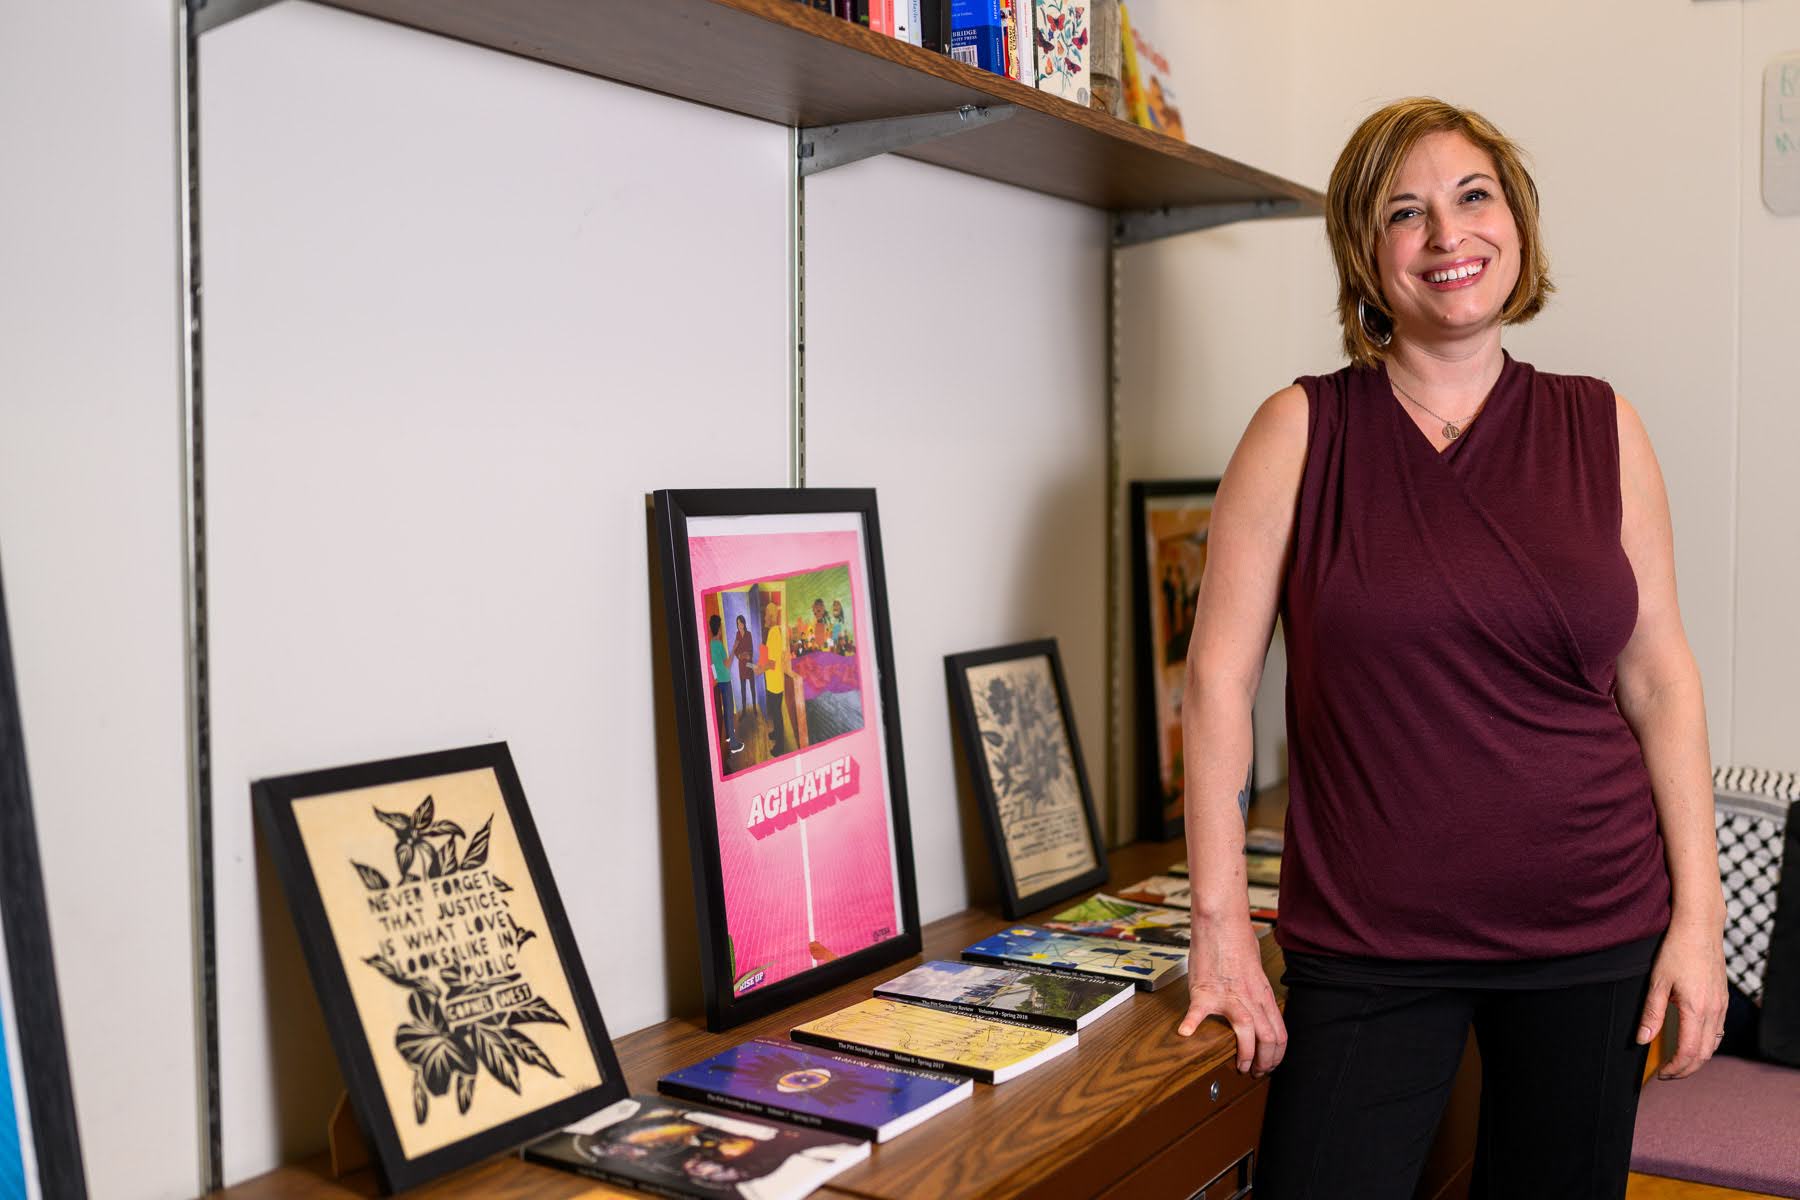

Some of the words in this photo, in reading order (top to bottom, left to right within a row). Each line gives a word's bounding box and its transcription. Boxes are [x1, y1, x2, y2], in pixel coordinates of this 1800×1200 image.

[745, 754, 852, 829] AGITATE!
[367, 886, 424, 914] NEVER
[432, 870, 492, 899] FORGET
[379, 908, 425, 933] THAT
[437, 892, 499, 921] JUSTICE
[380, 936, 396, 958] IS
[404, 923, 458, 953] WHAT
[465, 913, 508, 936] LOVE
[396, 952, 451, 978] LOOKS
[458, 937, 491, 963] LIKE
[498, 925, 514, 948] IN
[462, 954, 518, 983] PUBLIC
[1001, 1011, 1015, 1019] Spring
[874, 1049, 889, 1058] Review
[894, 1053, 910, 1062] Volume
[917, 1058, 932, 1067] Spring
[932, 1061, 944, 1069] 2017
